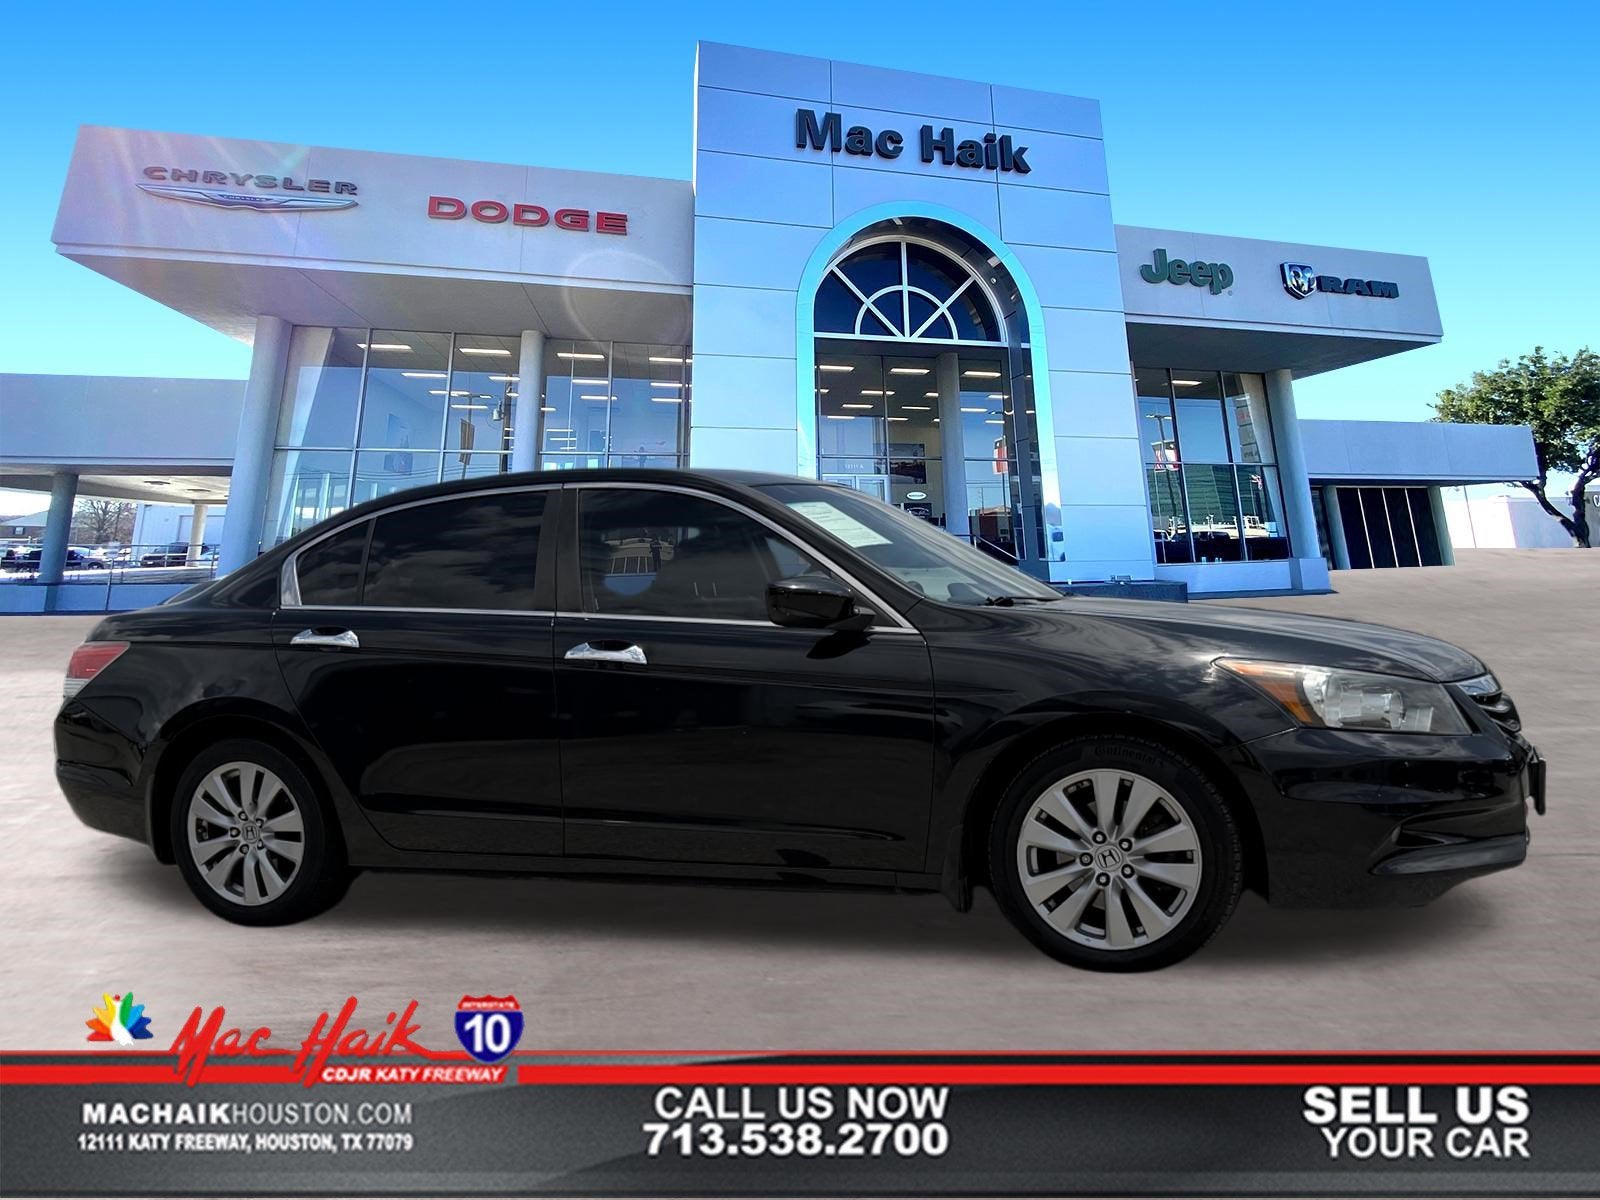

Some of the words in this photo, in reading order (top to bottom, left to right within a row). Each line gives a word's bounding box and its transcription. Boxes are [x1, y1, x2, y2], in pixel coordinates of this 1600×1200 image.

[796, 108, 904, 160] Mac
[919, 124, 1032, 174] Haik
[143, 166, 358, 196] CHRYSLER
[427, 195, 628, 236] DODGE
[1140, 248, 1234, 295] Jeep
[1315, 275, 1400, 298] RAM
